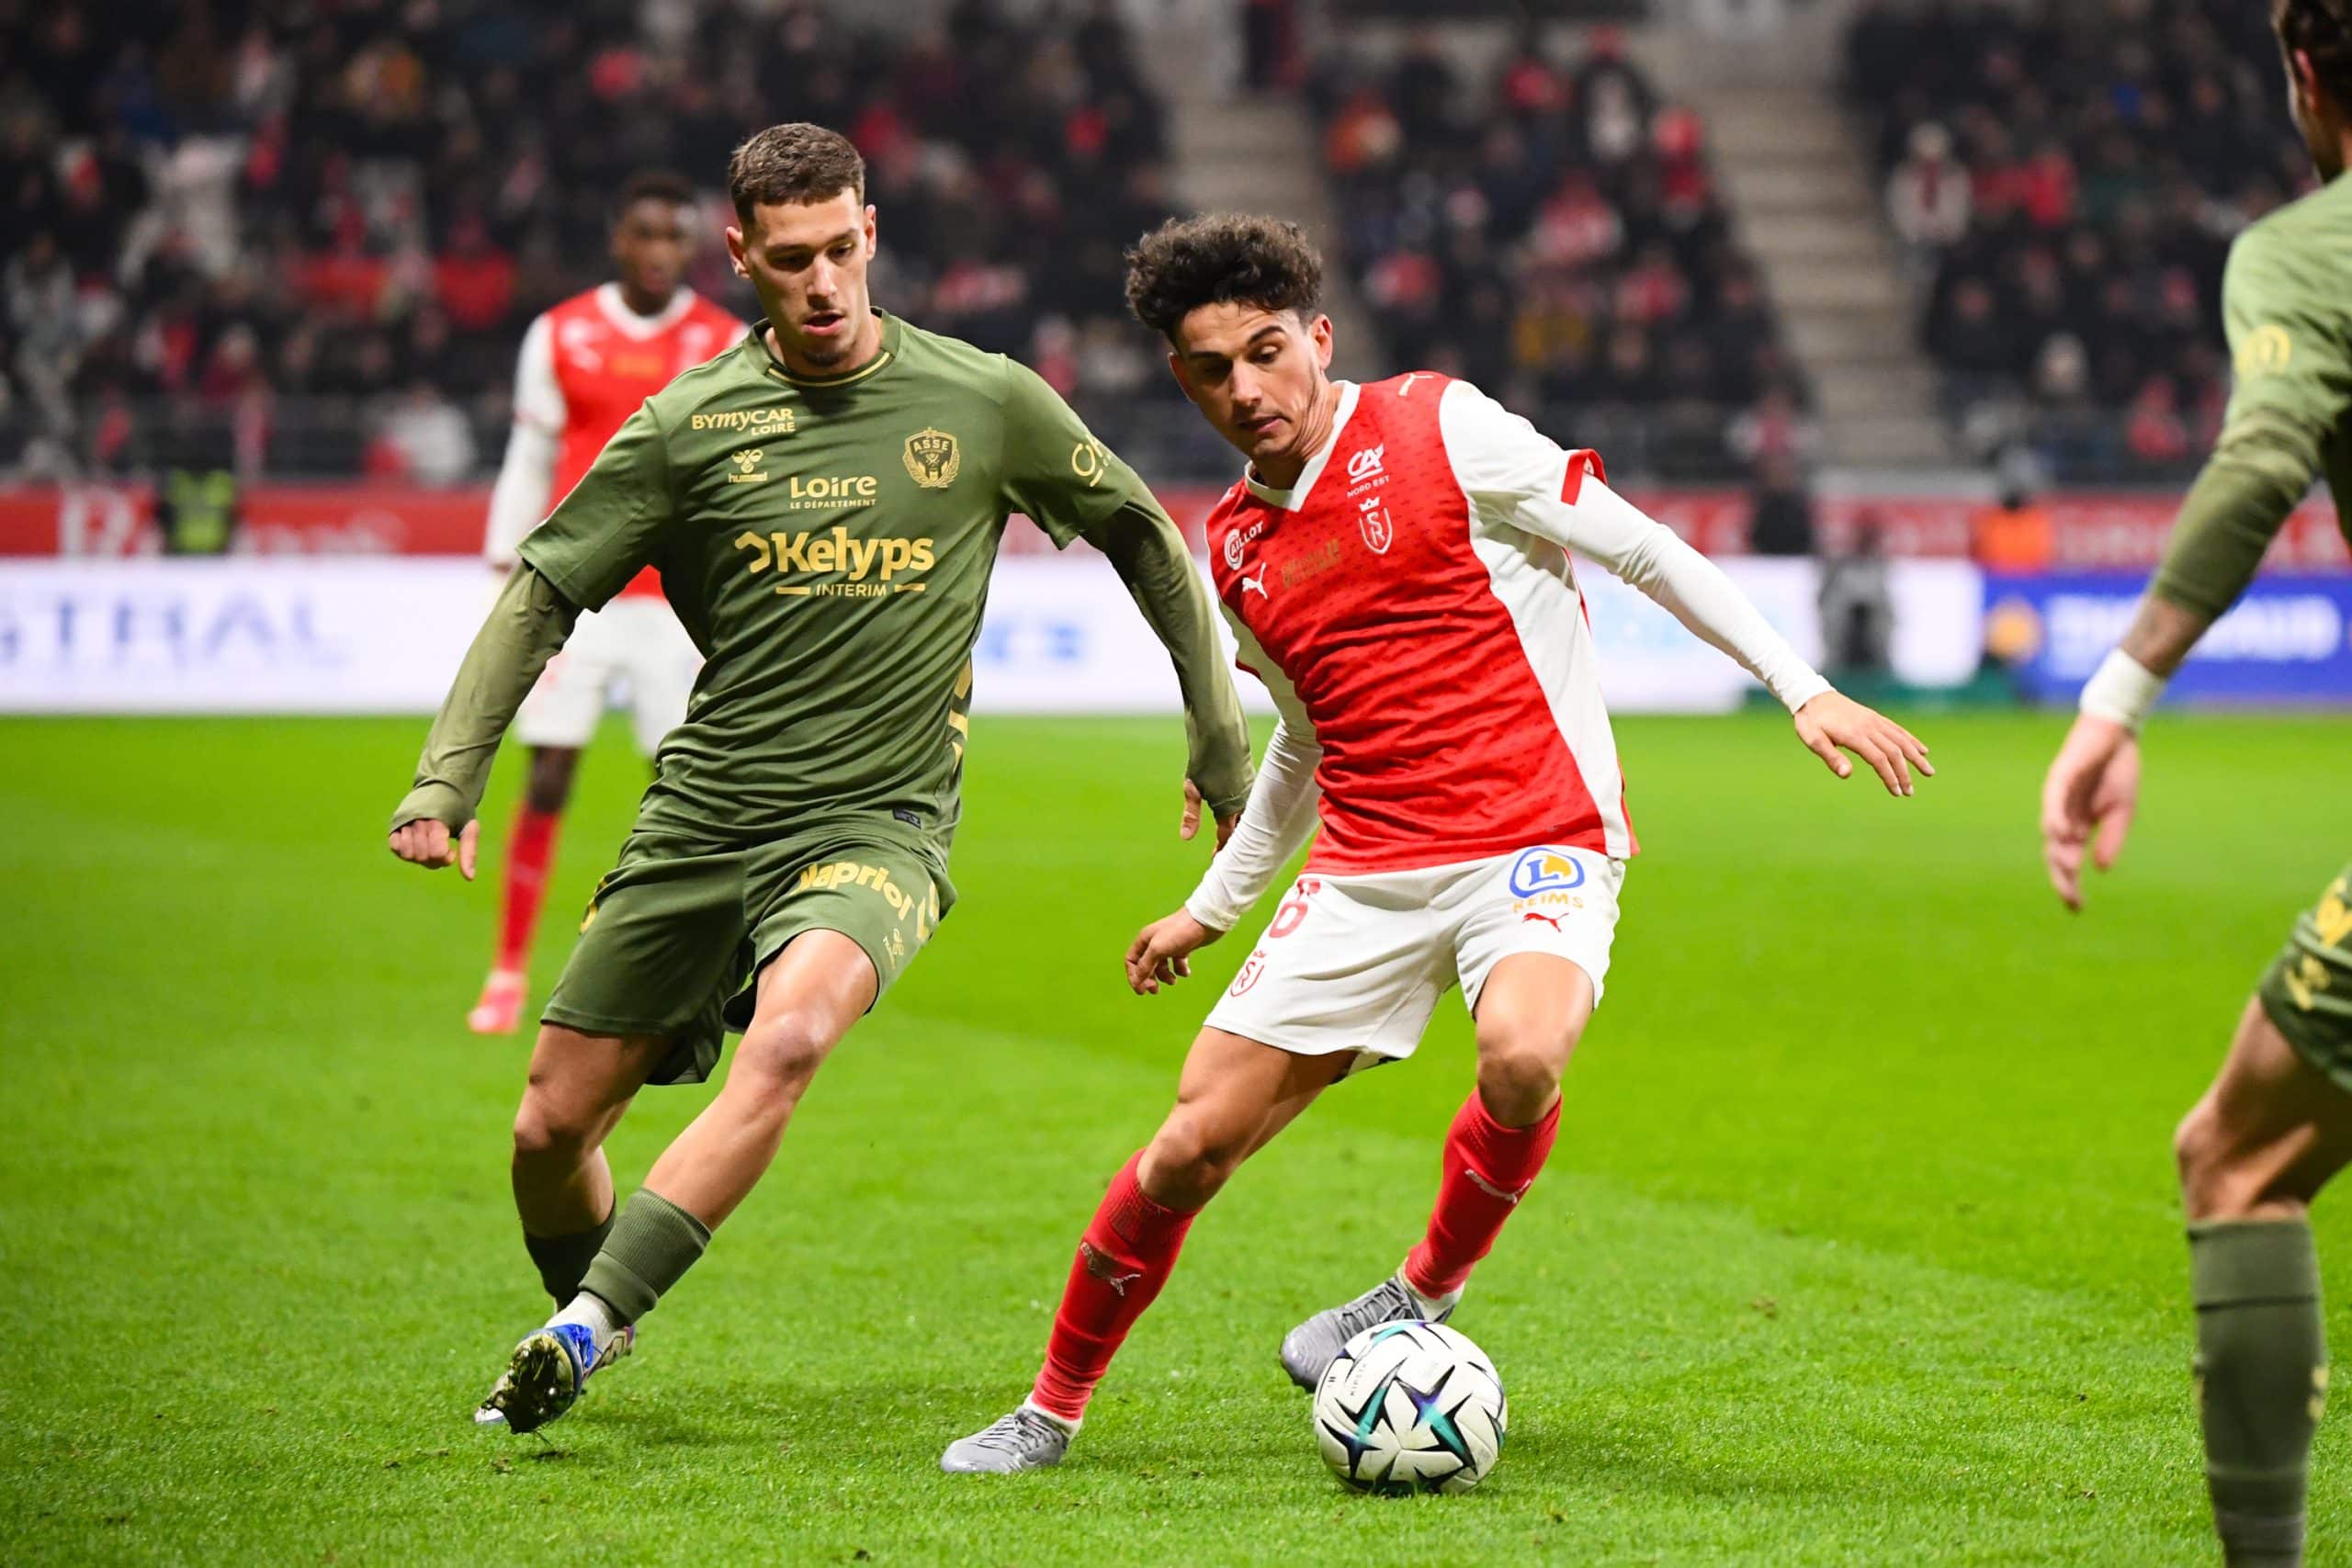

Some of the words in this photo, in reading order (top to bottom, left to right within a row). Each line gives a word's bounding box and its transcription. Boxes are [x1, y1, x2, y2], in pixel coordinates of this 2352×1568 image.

[751, 422, 796, 436] LOIRE
[913, 439, 950, 452] ASSE
[1347, 482, 1372, 499] NORD
[1372, 475, 1390, 488] EST
[790, 501, 801, 510] LE
[804, 499, 876, 509] DÉPARTEMENT
[771, 526, 935, 581] Kelyps
[816, 583, 888, 597] INTERIM
[1513, 892, 1585, 914] REIMS
